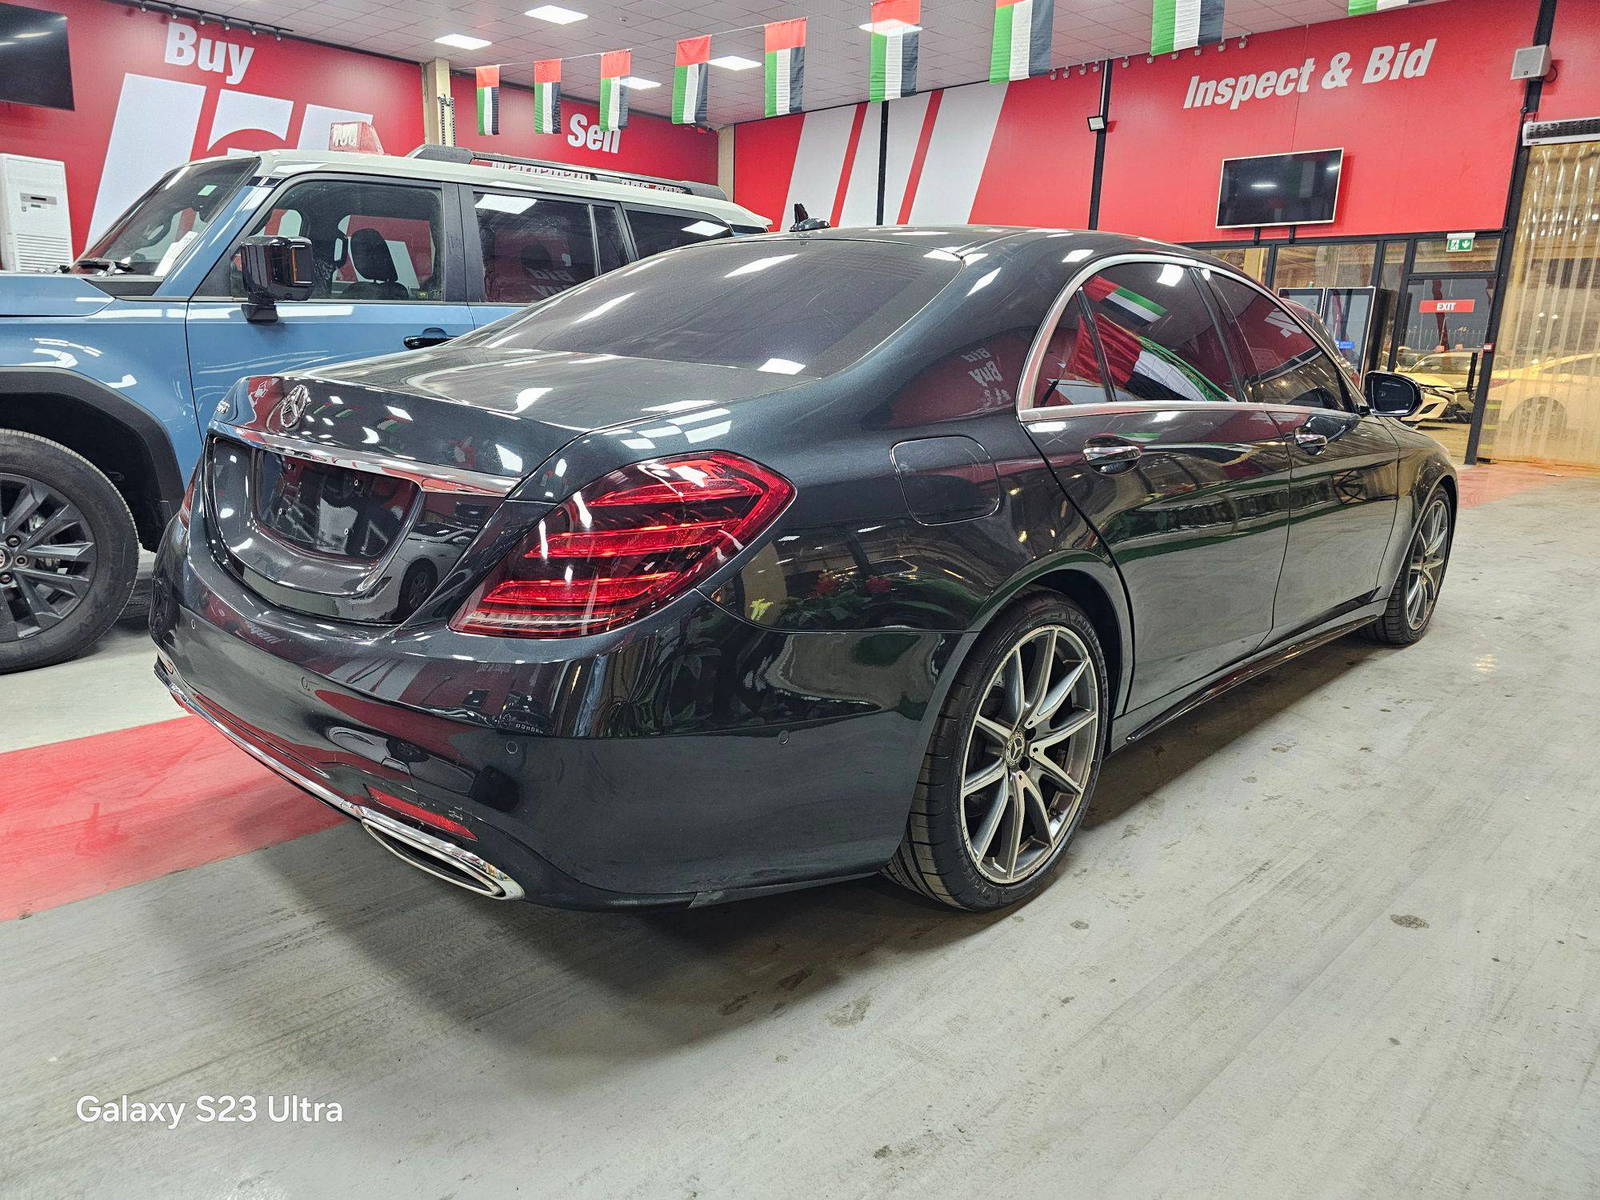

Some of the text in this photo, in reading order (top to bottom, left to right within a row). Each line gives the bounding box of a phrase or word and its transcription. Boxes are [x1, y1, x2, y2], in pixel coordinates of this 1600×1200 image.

[164, 21, 255, 85] Buy
[1183, 38, 1437, 110] Inspect & Bid
[567, 113, 621, 154] Sell
[1436, 302, 1456, 311] EXIT
